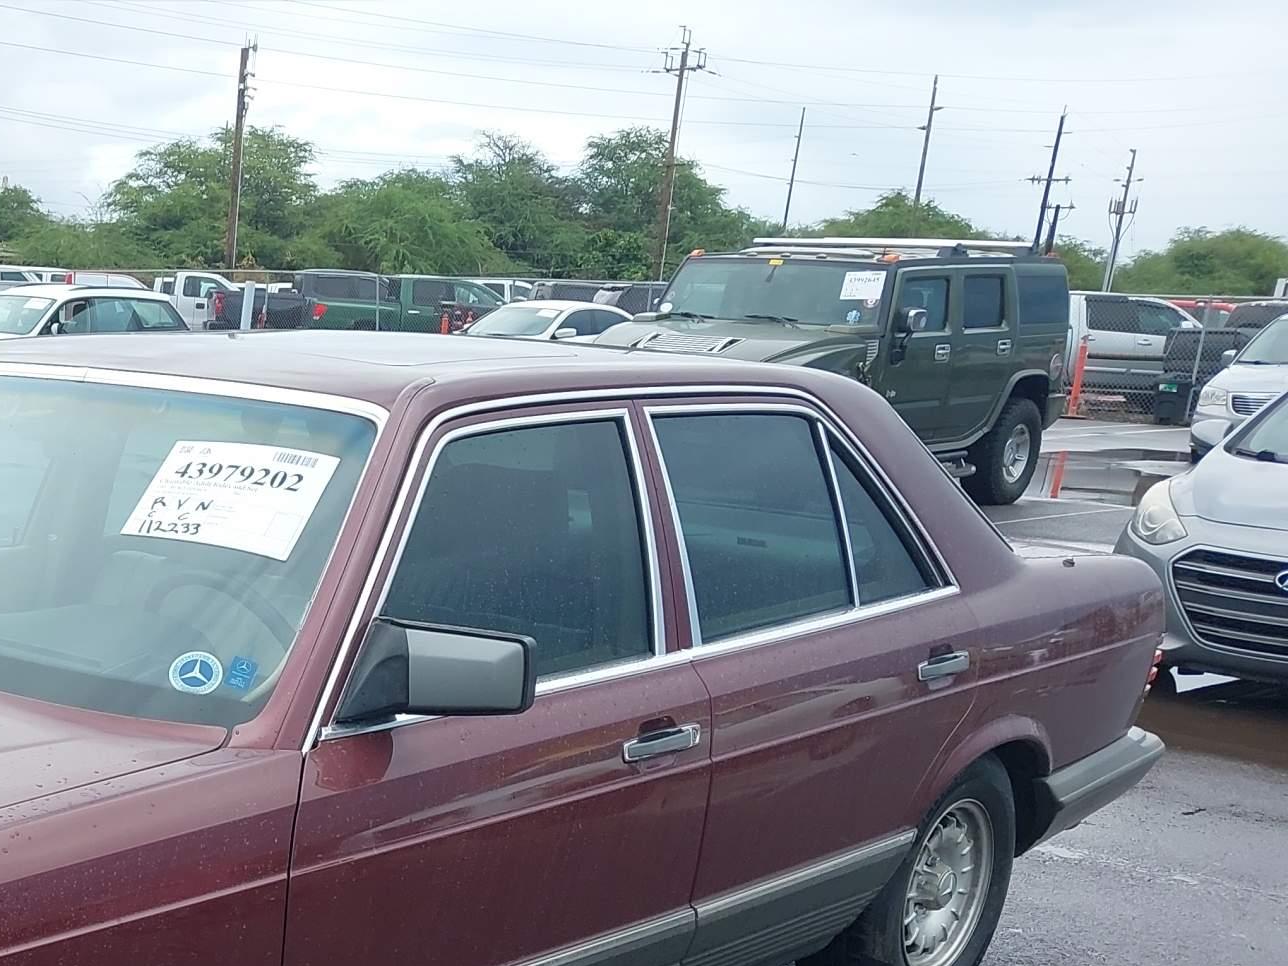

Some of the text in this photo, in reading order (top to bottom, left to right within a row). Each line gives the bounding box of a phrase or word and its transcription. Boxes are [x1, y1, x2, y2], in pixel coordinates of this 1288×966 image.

[174, 461, 304, 493] 43979202
[195, 499, 214, 511] N
[138, 519, 201, 535] 112233
